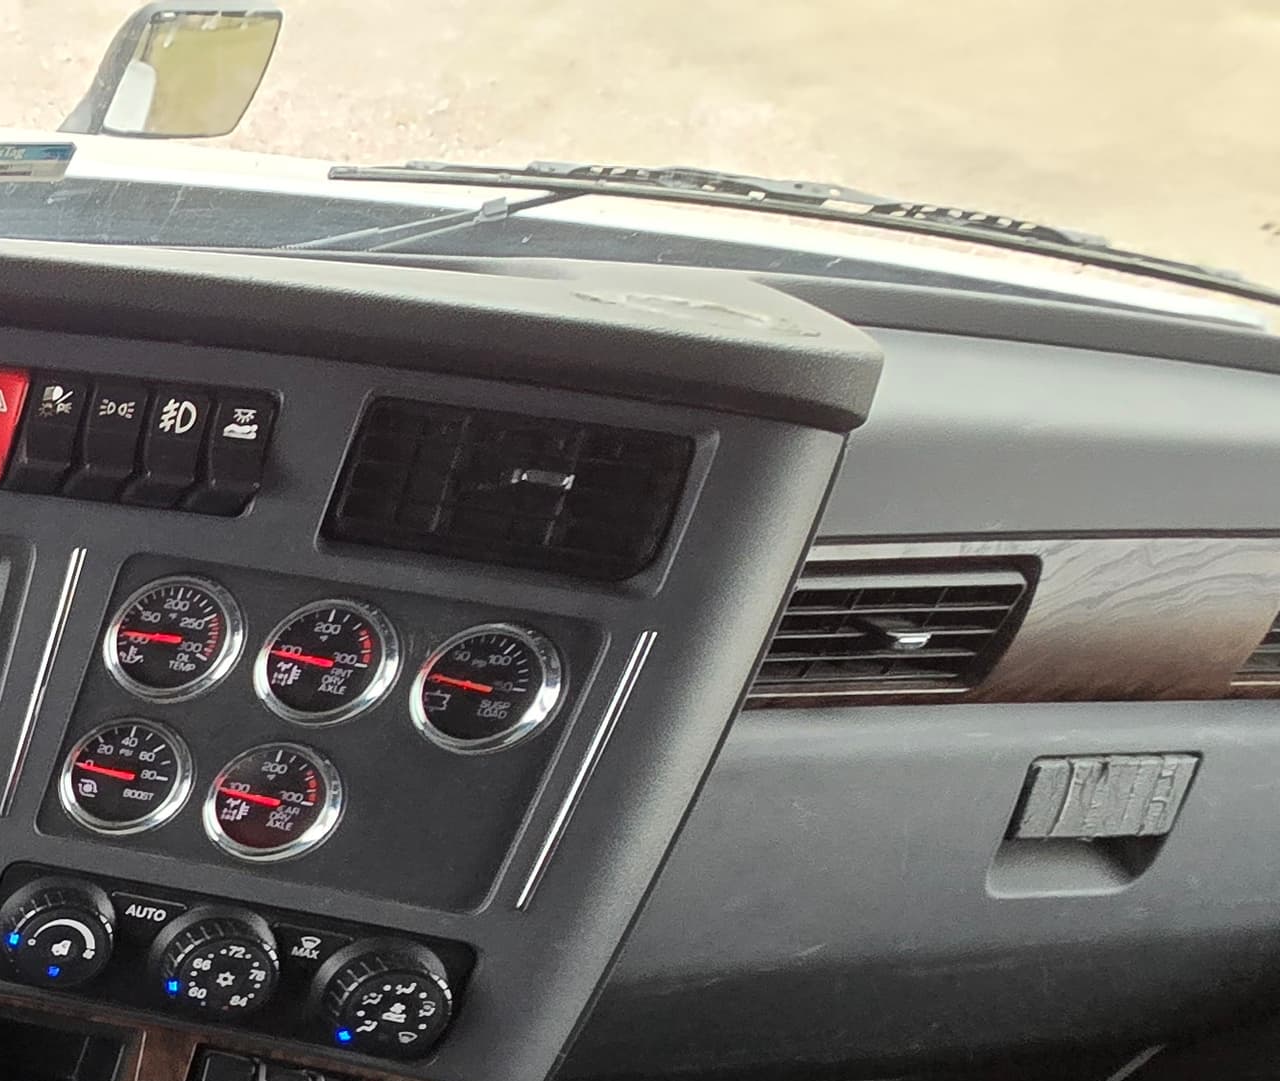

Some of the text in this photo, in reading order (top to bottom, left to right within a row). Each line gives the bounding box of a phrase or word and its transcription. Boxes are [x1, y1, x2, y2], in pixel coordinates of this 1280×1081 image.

[163, 599, 190, 611] 200
[140, 611, 161, 623] 150
[179, 617, 205, 630] 250
[314, 622, 342, 635] 200
[334, 651, 358, 665] 300
[488, 654, 513, 666] 100
[168, 660, 197, 672] TEMP
[317, 683, 347, 695] AXLE
[476, 708, 508, 719] LOAD
[121, 737, 138, 748] 40
[97, 743, 114, 755] 20
[138, 751, 155, 762] 60
[261, 761, 288, 774] 200
[140, 769, 157, 780] 80
[122, 788, 154, 801] BOOST
[280, 790, 304, 803] 300
[265, 820, 293, 831] AXLE
[124, 903, 167, 922] AUTO
[228, 945, 246, 958] 72
[291, 946, 320, 959] MAX
[192, 958, 212, 971] 66
[248, 969, 266, 981] 78
[188, 986, 207, 999] 60
[229, 995, 248, 1007] 84
